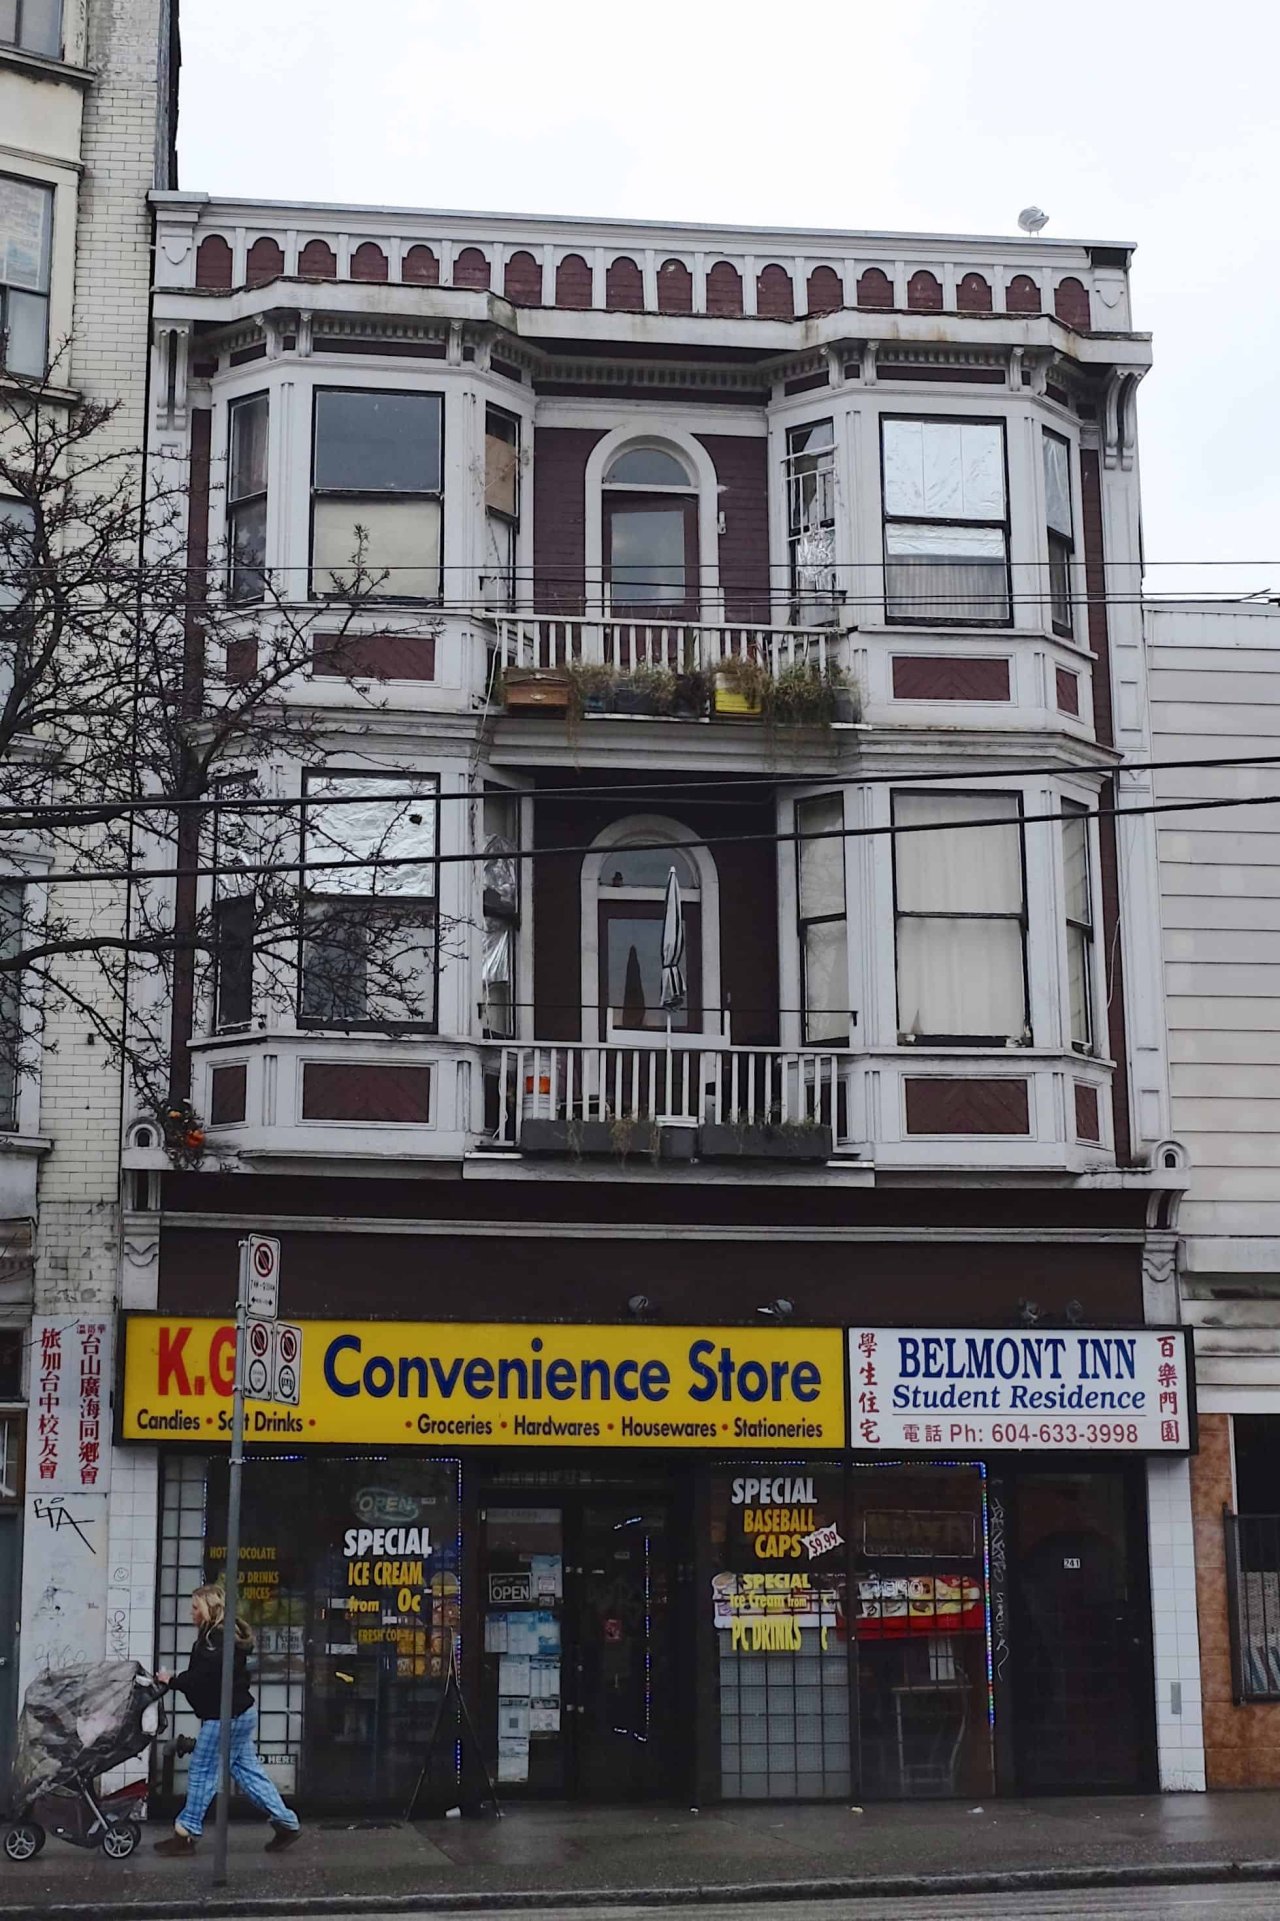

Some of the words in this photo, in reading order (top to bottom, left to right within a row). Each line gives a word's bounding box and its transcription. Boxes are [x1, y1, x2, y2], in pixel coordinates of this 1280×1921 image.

[324, 1334, 670, 1401] Convenience
[688, 1339, 821, 1402] Store
[898, 1337, 1066, 1379] BELMONT
[1077, 1338, 1136, 1379] INN
[858, 1332, 880, 1443] 學生住宅
[892, 1384, 1000, 1408] Student
[1009, 1384, 1145, 1409] Residence
[38, 1328, 62, 1479] 旅加台中校友會
[78, 1334, 101, 1485] 台山廣海同鄉會
[137, 1408, 200, 1431] Candies
[255, 1410, 303, 1432] Drinks
[418, 1413, 492, 1435] Groceries
[514, 1415, 600, 1436] Hardwares
[621, 1416, 717, 1437] Housewares
[734, 1417, 823, 1438] Stationeries
[903, 1424, 942, 1443] 電話
[950, 1424, 983, 1442] Ph:
[992, 1423, 1138, 1443] 604-633-3998
[731, 1477, 817, 1504] SPECIAL
[359, 1495, 413, 1512] OPEN
[744, 1508, 815, 1533] BASEBALL
[209, 1547, 227, 1559] HOT
[343, 1527, 432, 1557] SPECIAL
[755, 1534, 801, 1558] CAPS
[348, 1561, 370, 1586] ICE
[374, 1561, 423, 1586] CREAM
[1064, 1559, 1079, 1568] 241
[248, 1571, 279, 1584] DRINKS
[743, 1573, 811, 1589] SPECIAL
[243, 1587, 271, 1600] JUICES
[349, 1596, 380, 1613] from
[492, 1585, 529, 1600] OPEN
[752, 1615, 802, 1651] DRINKS
[268, 1755, 296, 1764] HERE
